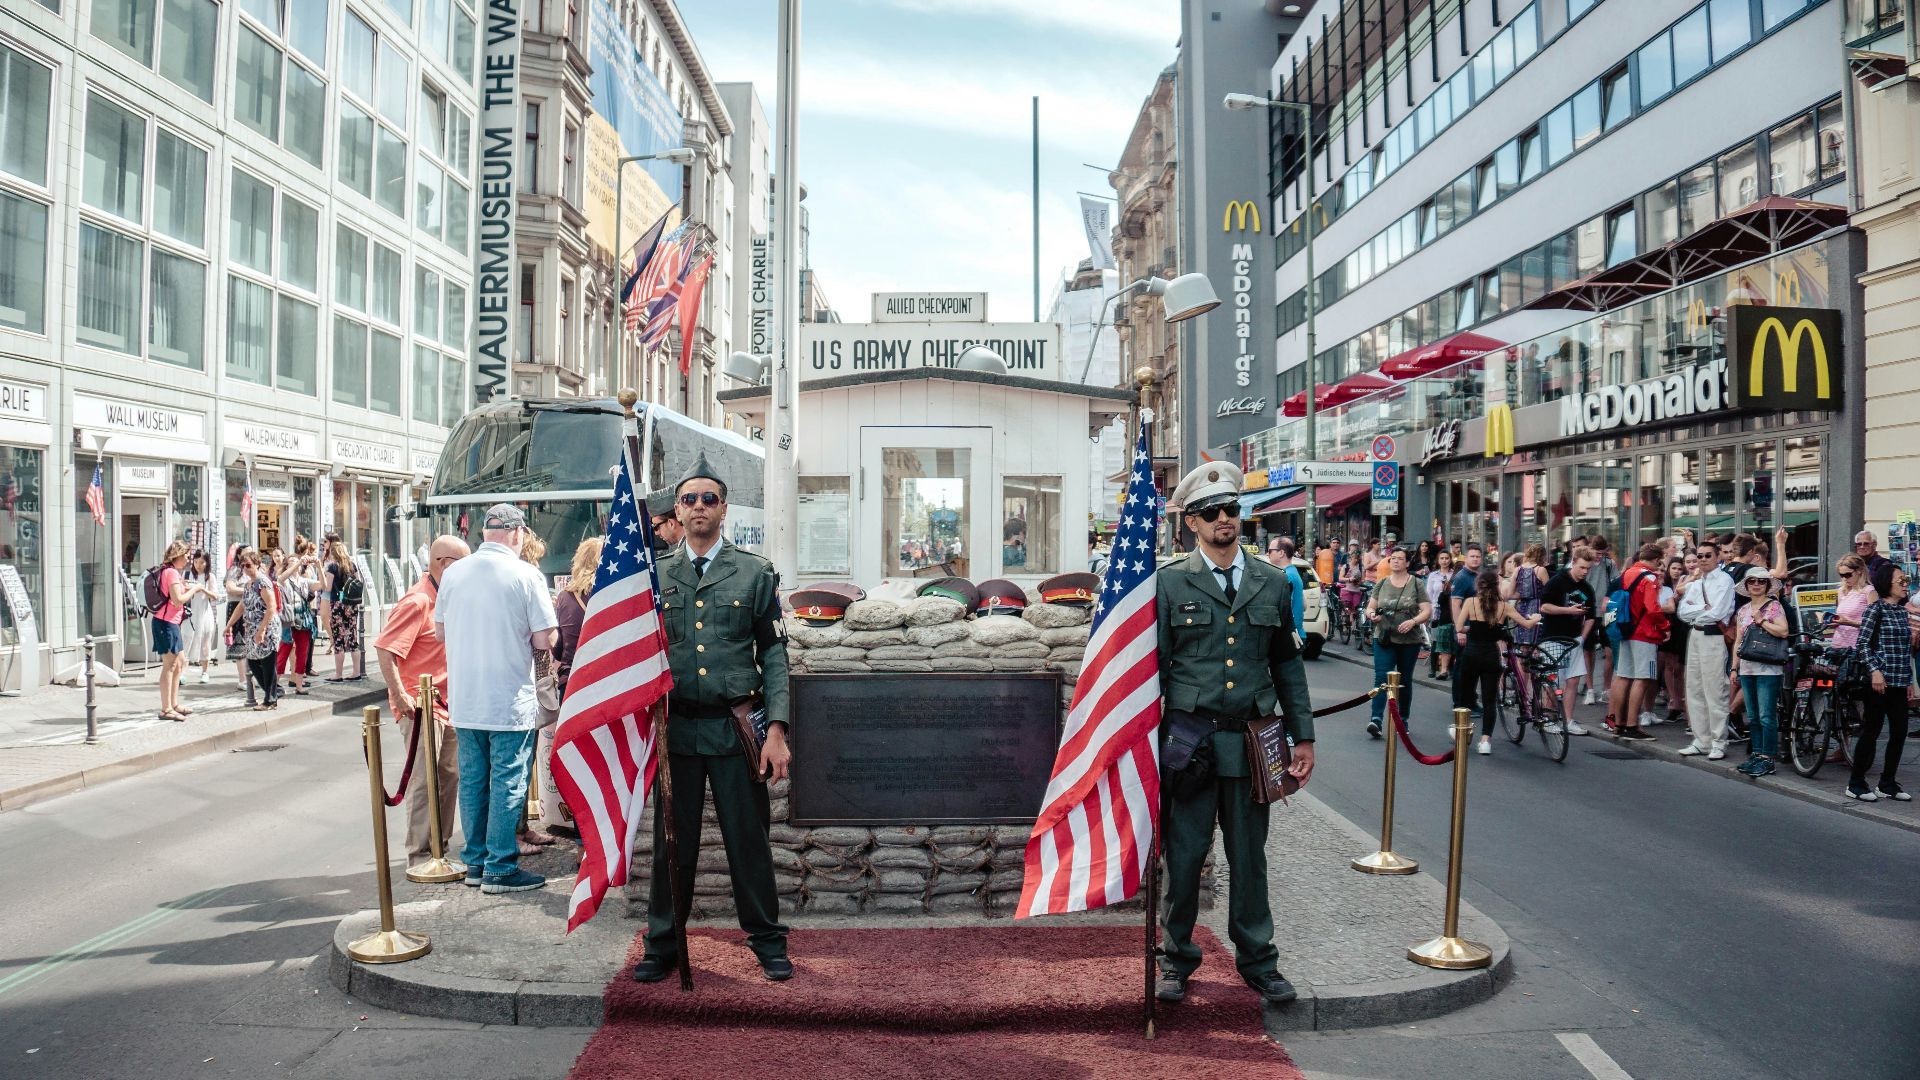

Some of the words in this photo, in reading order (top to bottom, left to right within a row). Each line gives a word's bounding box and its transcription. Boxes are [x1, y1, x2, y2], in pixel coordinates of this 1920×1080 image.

[484, 54, 515, 111] THE
[476, 126, 514, 396] MAUERMUSEUM
[752, 238, 767, 303] CHARLIE
[887, 297, 915, 314] ALLIED
[919, 297, 972, 314] CHECKPOINT
[853, 339, 911, 369] ARMY
[1217, 396, 1267, 417] McCafé
[106, 404, 135, 428] WALL
[137, 410, 178, 433] MUSEUM
[244, 427, 299, 451] MAUERMUSEUM
[337, 442, 372, 460] CHECKPOINT
[373, 446, 395, 465] CHARLIE
[131, 467, 155, 479] MUSEUM
[1316, 468, 1346, 477] Jüdisches
[1801, 594, 1824, 602] TICKETS
